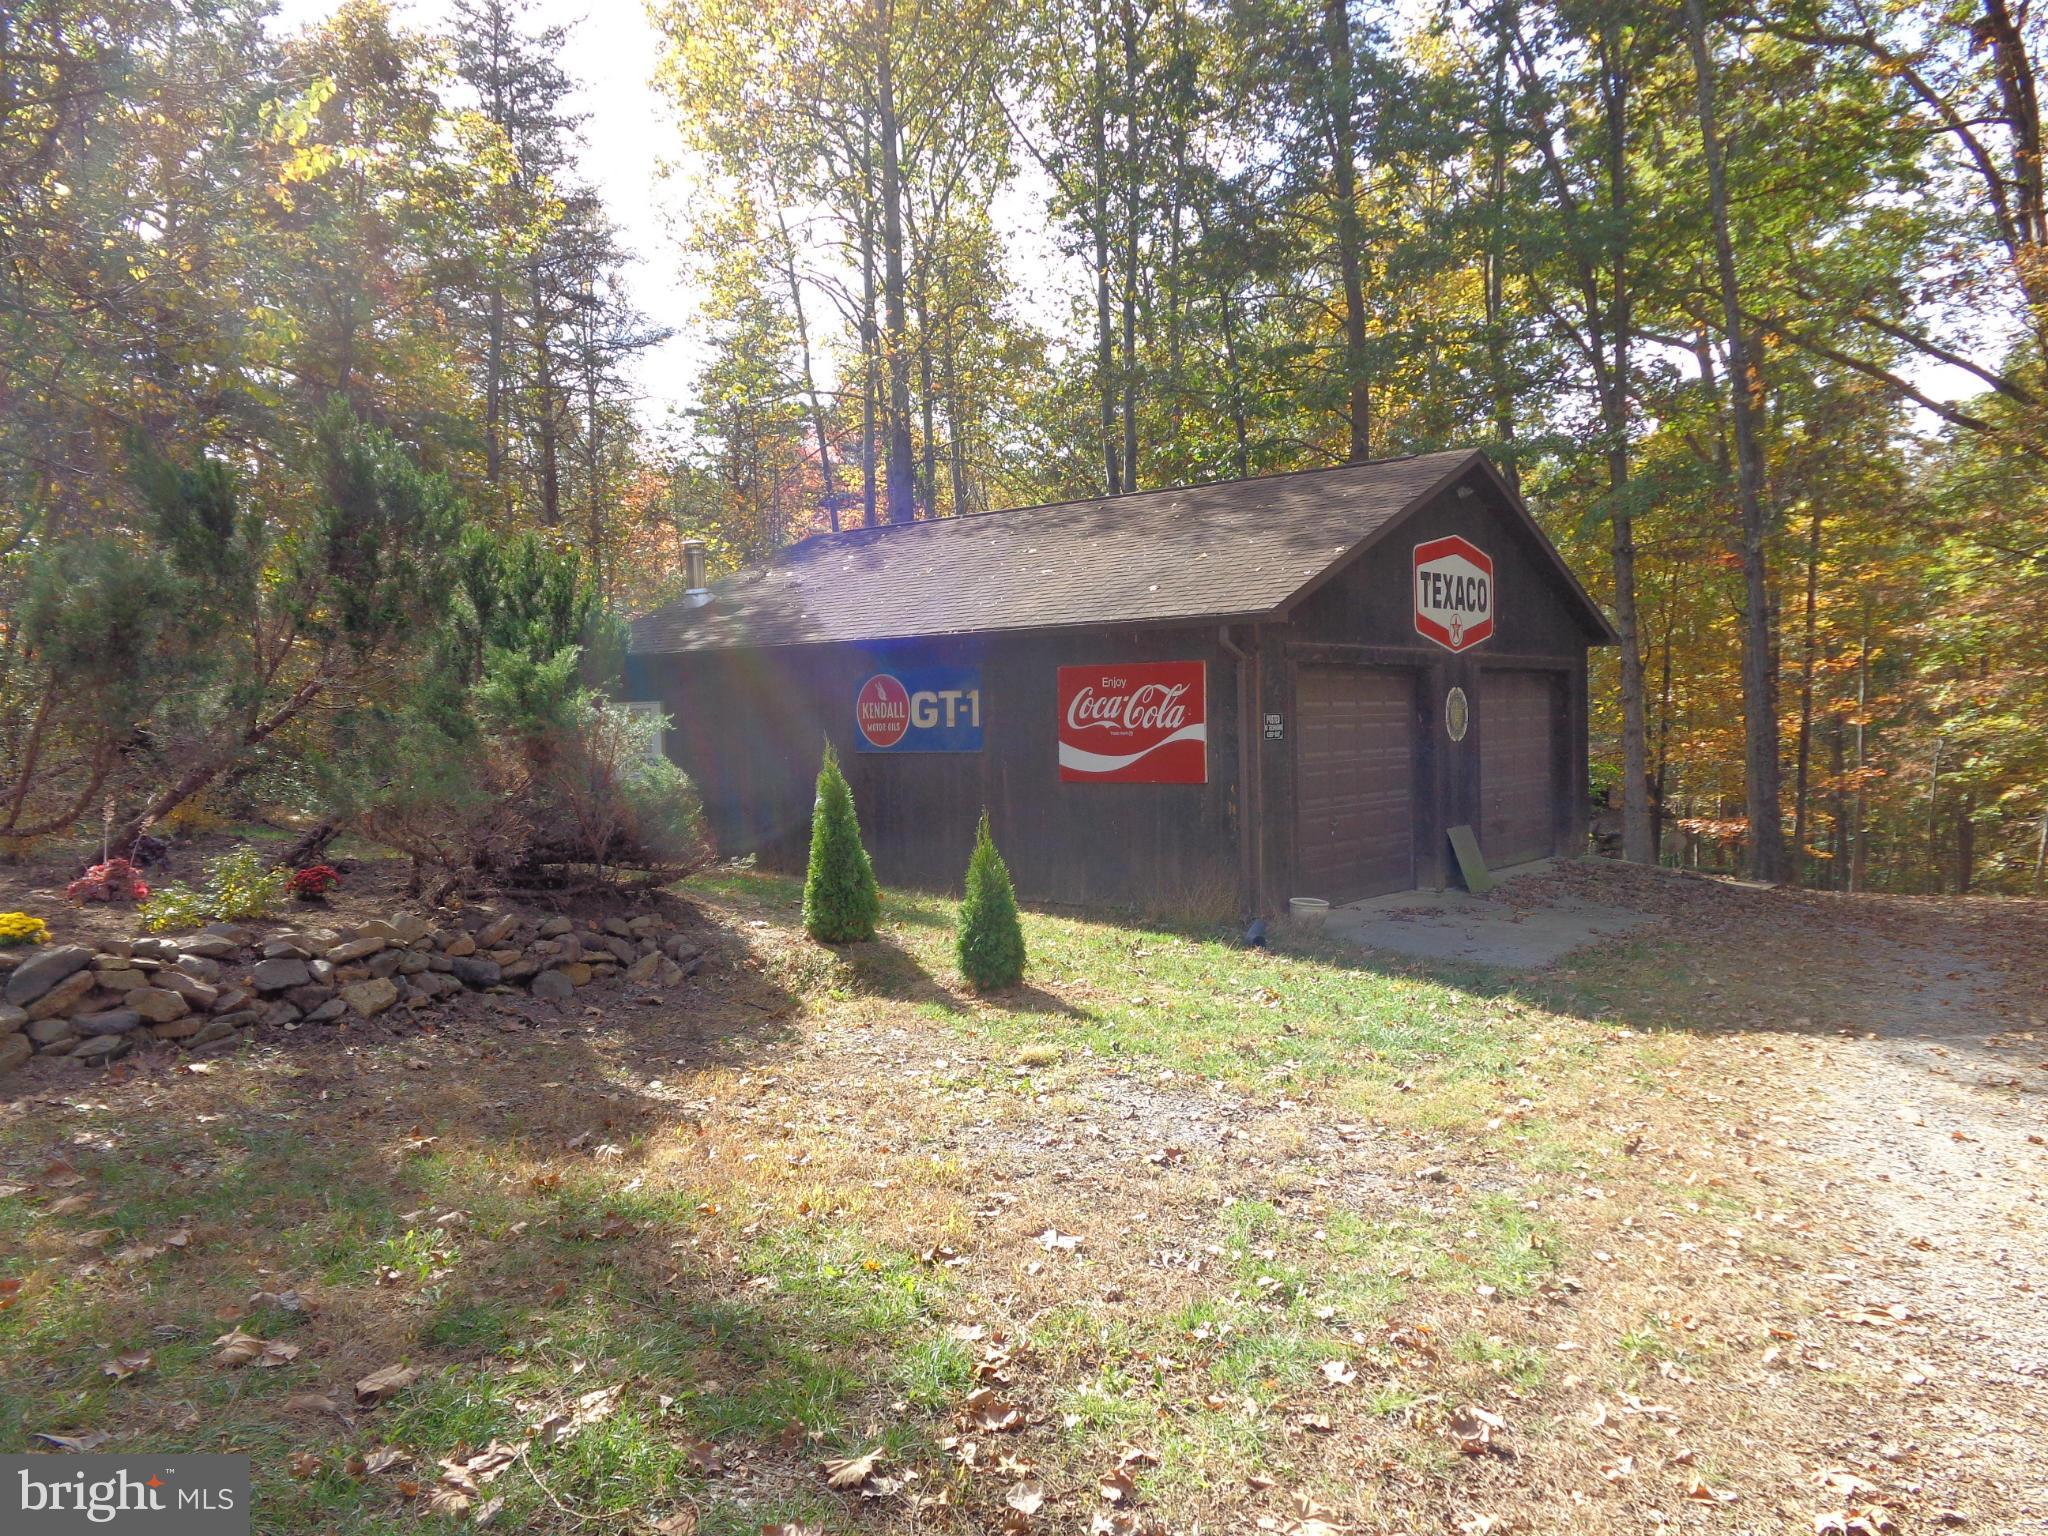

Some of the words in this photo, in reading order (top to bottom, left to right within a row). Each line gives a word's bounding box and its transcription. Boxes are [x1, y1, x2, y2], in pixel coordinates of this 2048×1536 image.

[1420, 571, 1488, 613] TEXACO
[1102, 677, 1127, 689] Enjoy
[862, 702, 905, 719] KENDALL
[911, 688, 980, 729] GT-1
[1067, 682, 1191, 730] Coca-Cola
[867, 722, 886, 732] MOTOR
[887, 722, 901, 732] OILS
